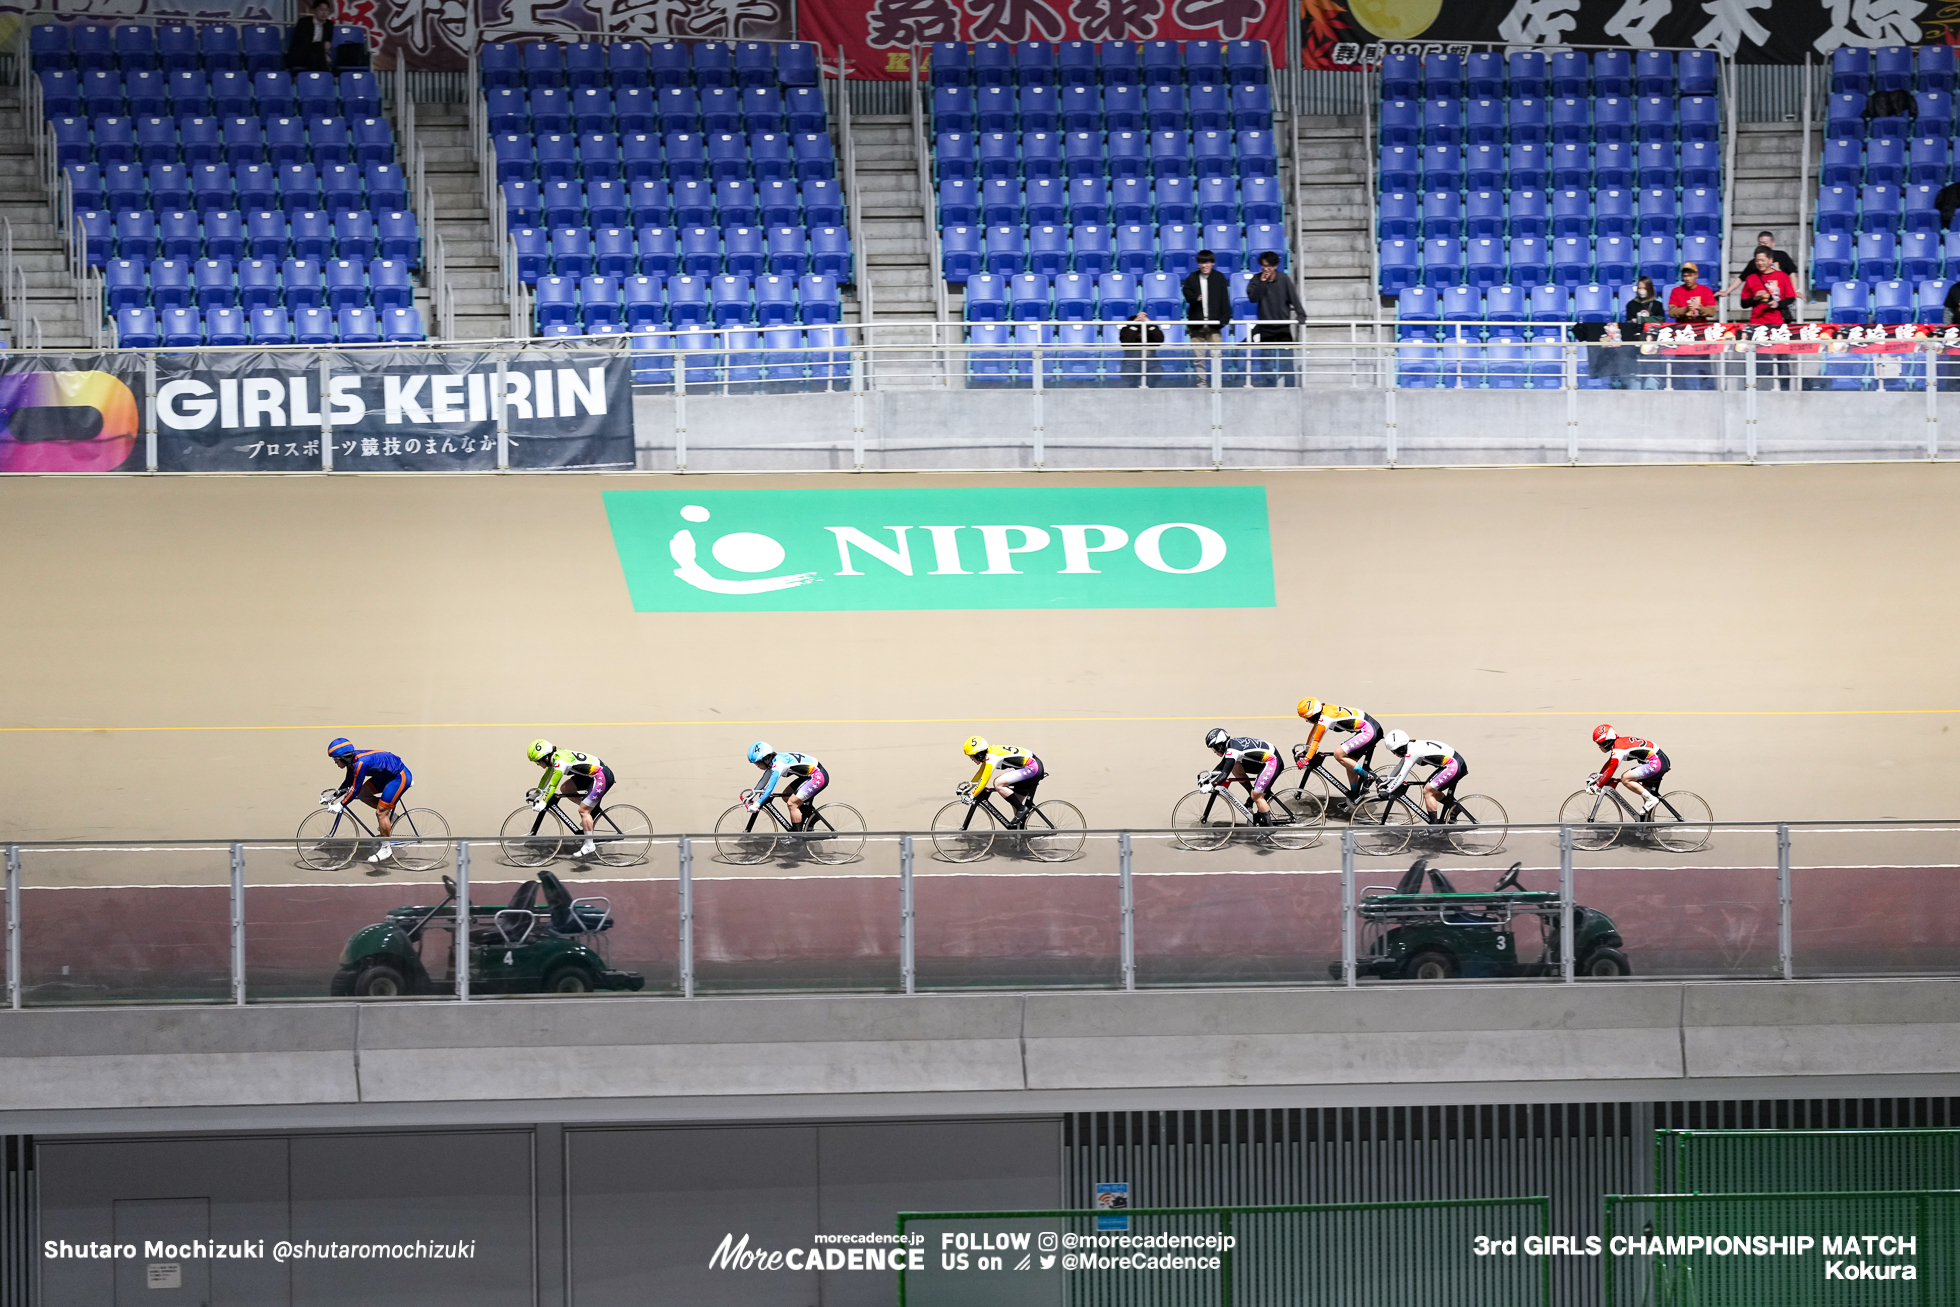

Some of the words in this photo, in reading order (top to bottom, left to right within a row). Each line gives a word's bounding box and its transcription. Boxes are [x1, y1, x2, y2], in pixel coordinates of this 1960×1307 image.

[156, 375, 366, 430] GIRLS
[384, 366, 607, 424] KEIRIN
[823, 522, 1227, 576] NIPPO
[1599, 725, 1606, 735] 3
[535, 742, 543, 752] 6
[971, 738, 978, 747] 5
[754, 744, 761, 753] 4
[571, 751, 588, 762] 6
[1496, 935, 1507, 951] 3
[503, 950, 514, 965] 4
